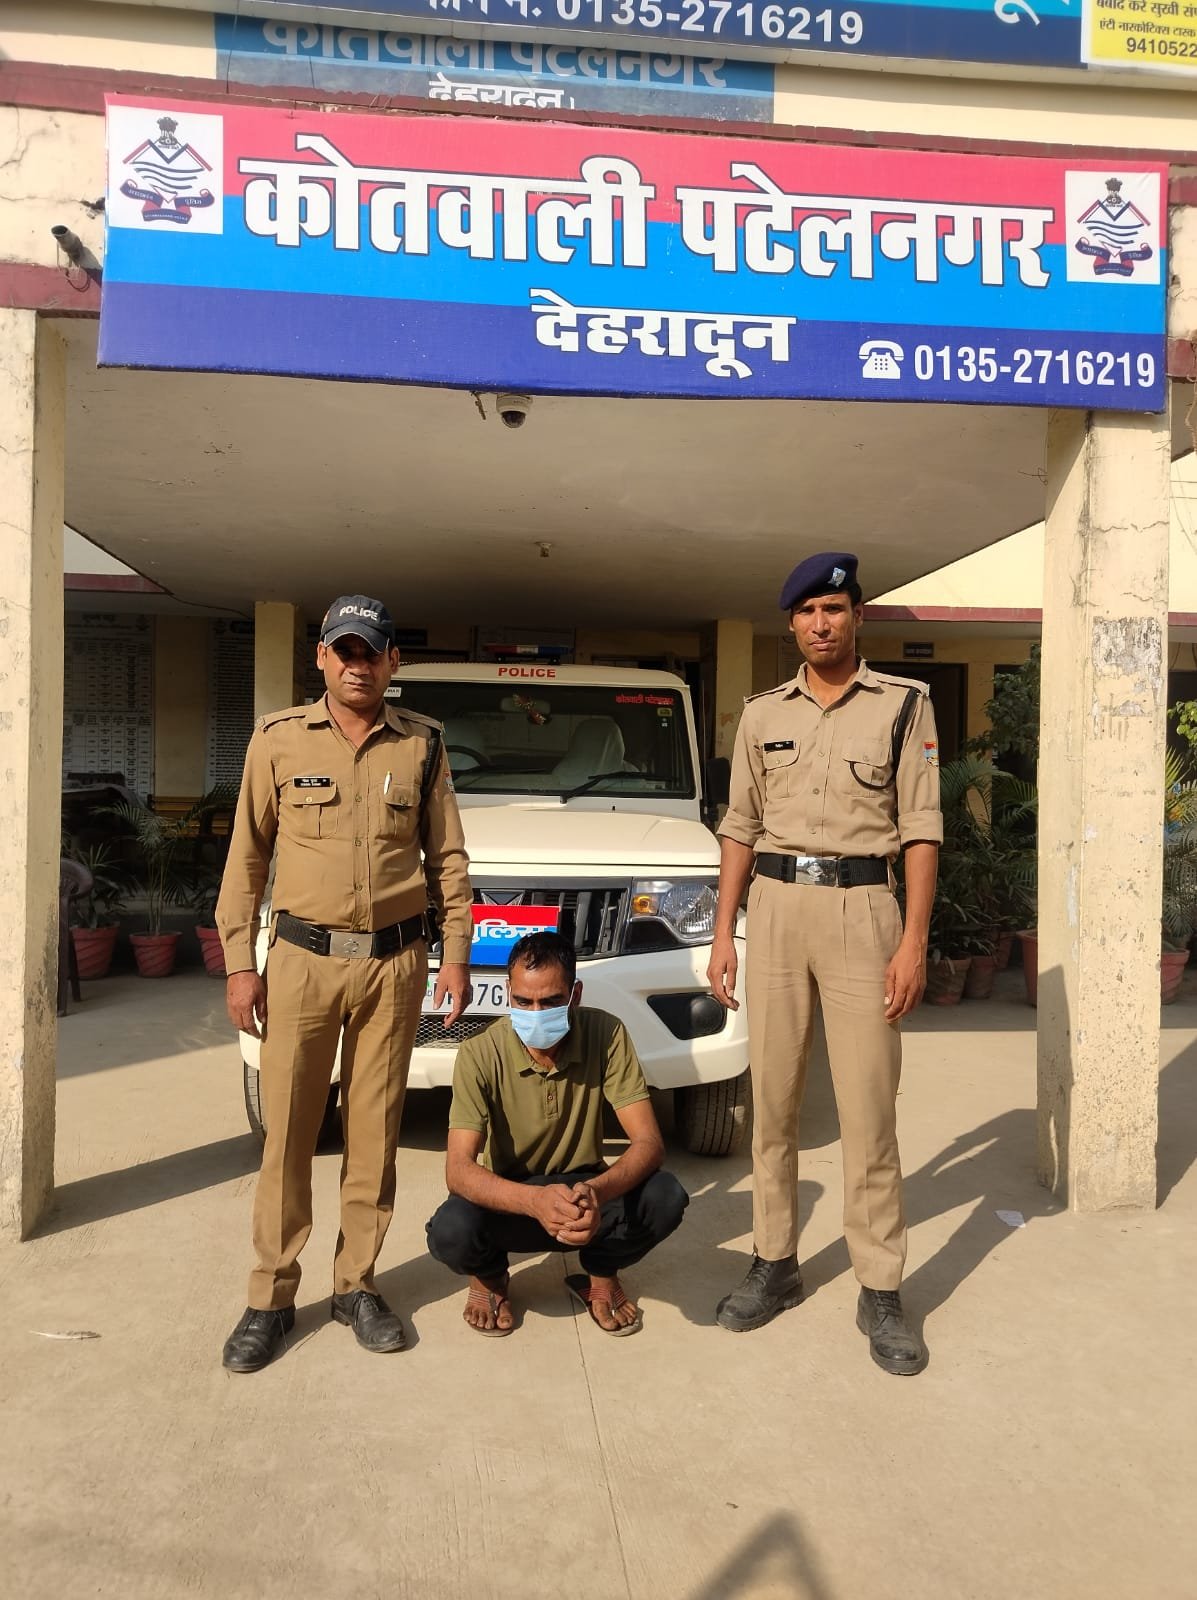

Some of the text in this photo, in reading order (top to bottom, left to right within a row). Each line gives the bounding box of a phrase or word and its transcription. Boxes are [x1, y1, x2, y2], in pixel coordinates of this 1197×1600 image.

[556, 0, 863, 44] 0135-2716219
[238, 132, 1055, 288] कोतवाली पटेलनगर
[529, 288, 797, 379] देहरादून
[914, 344, 1156, 388] 0135-2716219
[339, 605, 379, 621] POLICE
[498, 667, 556, 678] POLICE
